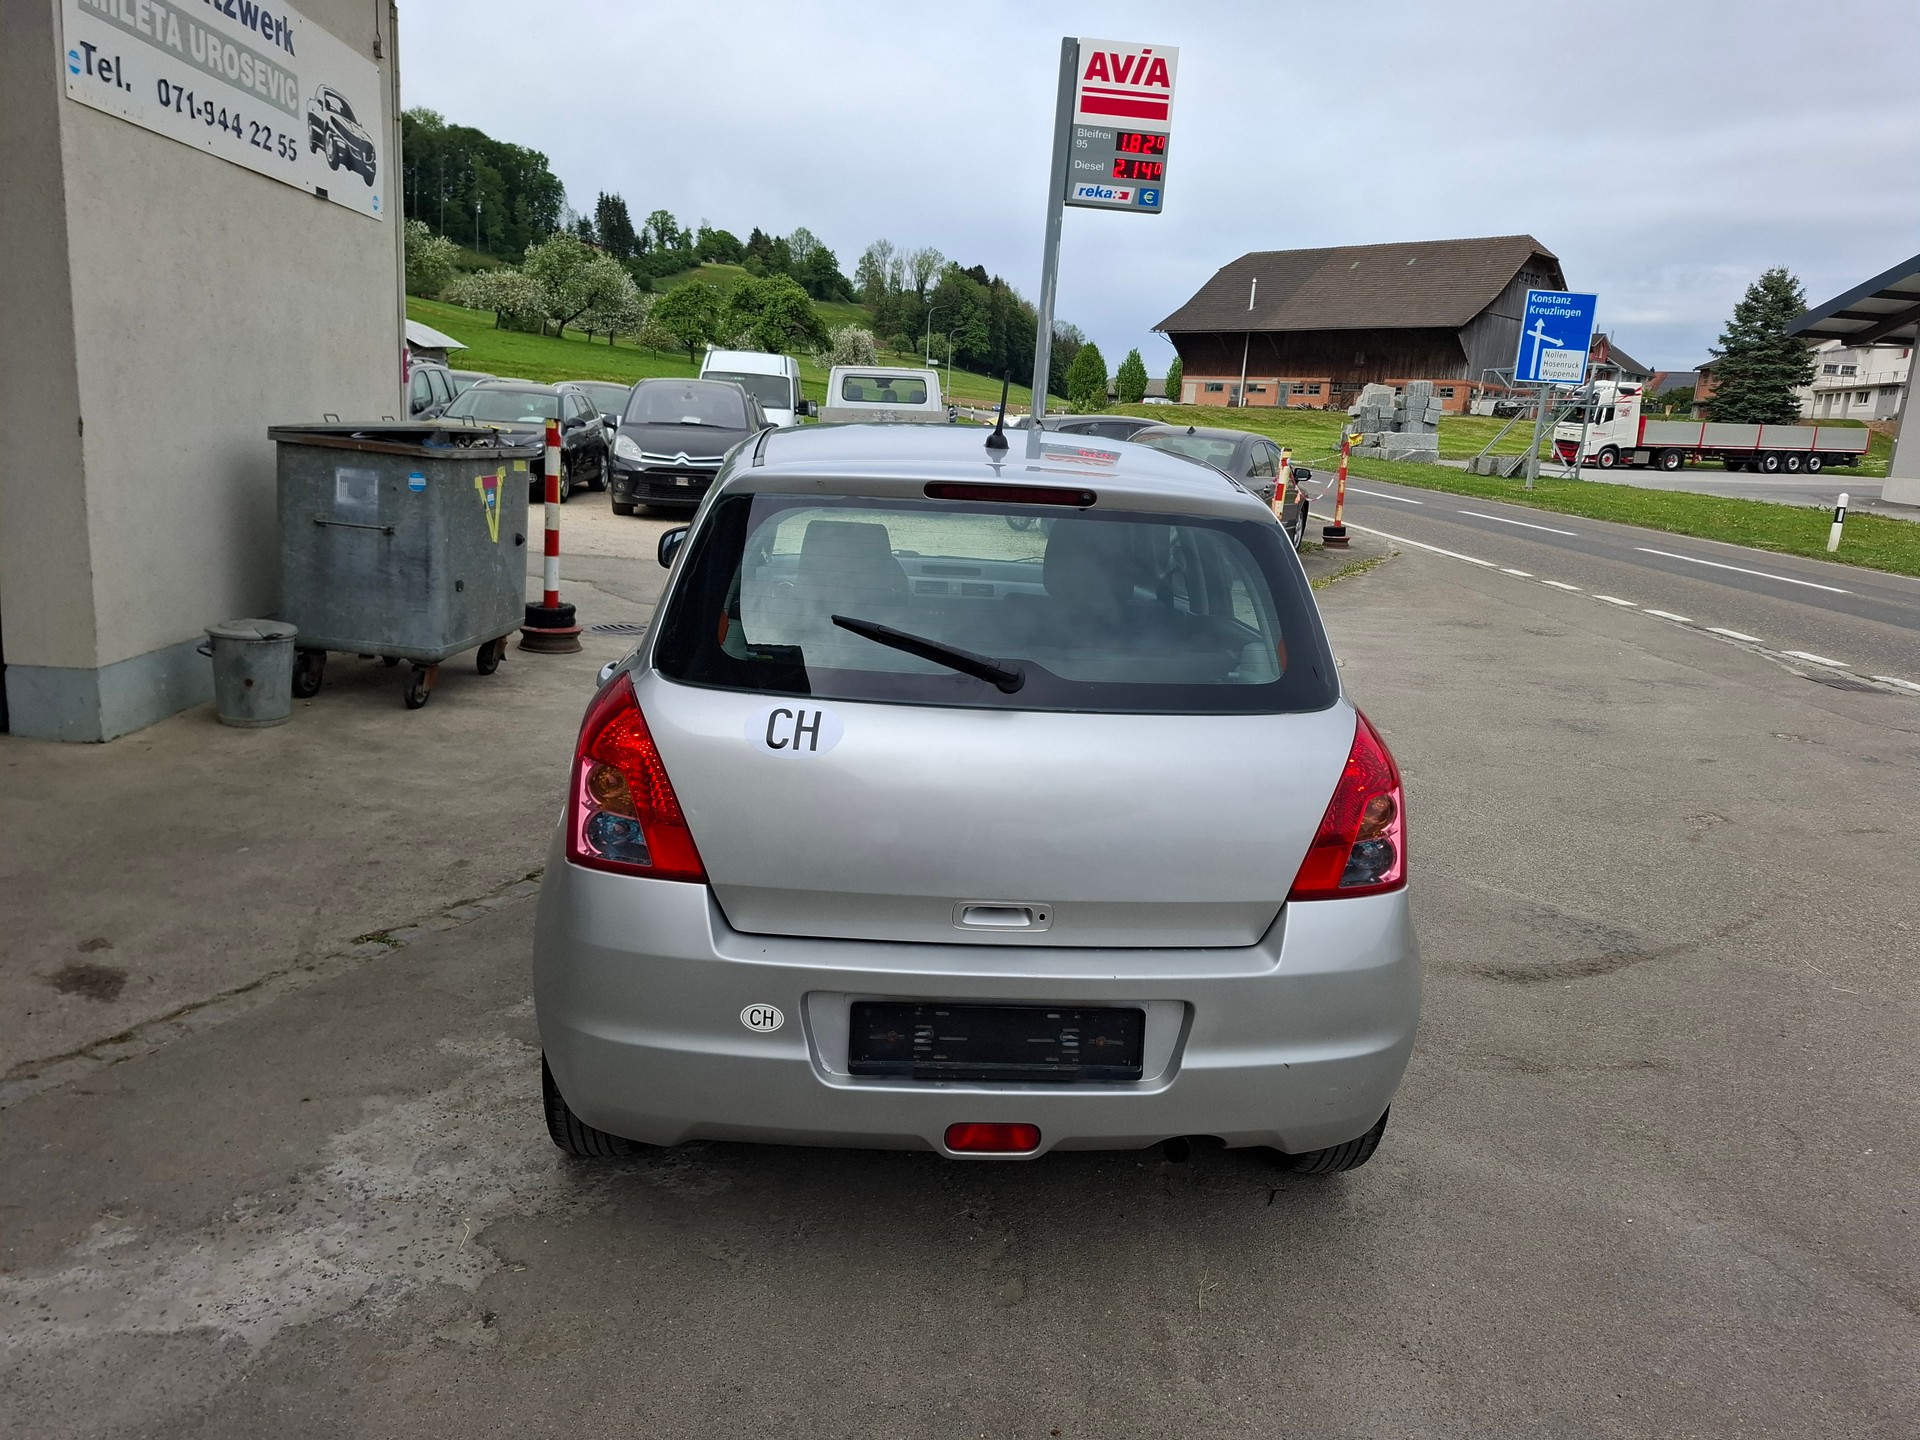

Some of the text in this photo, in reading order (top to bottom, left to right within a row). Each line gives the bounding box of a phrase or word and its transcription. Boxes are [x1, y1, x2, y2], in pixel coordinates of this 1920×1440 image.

[203, 0, 296, 57] zwerk
[188, 23, 298, 111] UROSEVIC
[1083, 48, 1171, 88] AVIA
[80, 40, 298, 162] Tel. 071-944 22 55
[1077, 127, 1111, 140] Bleifrei
[1076, 139, 1088, 149] 95
[1074, 159, 1105, 171] Diesel
[1531, 293, 1572, 305] Konstanz
[1529, 305, 1582, 319] Kreuzlingen
[1544, 350, 1568, 359] Nollen
[1543, 360, 1580, 369] Hosenruck
[1542, 369, 1580, 379] Wuppenau
[765, 708, 823, 752] CH
[750, 1009, 775, 1027] CH
